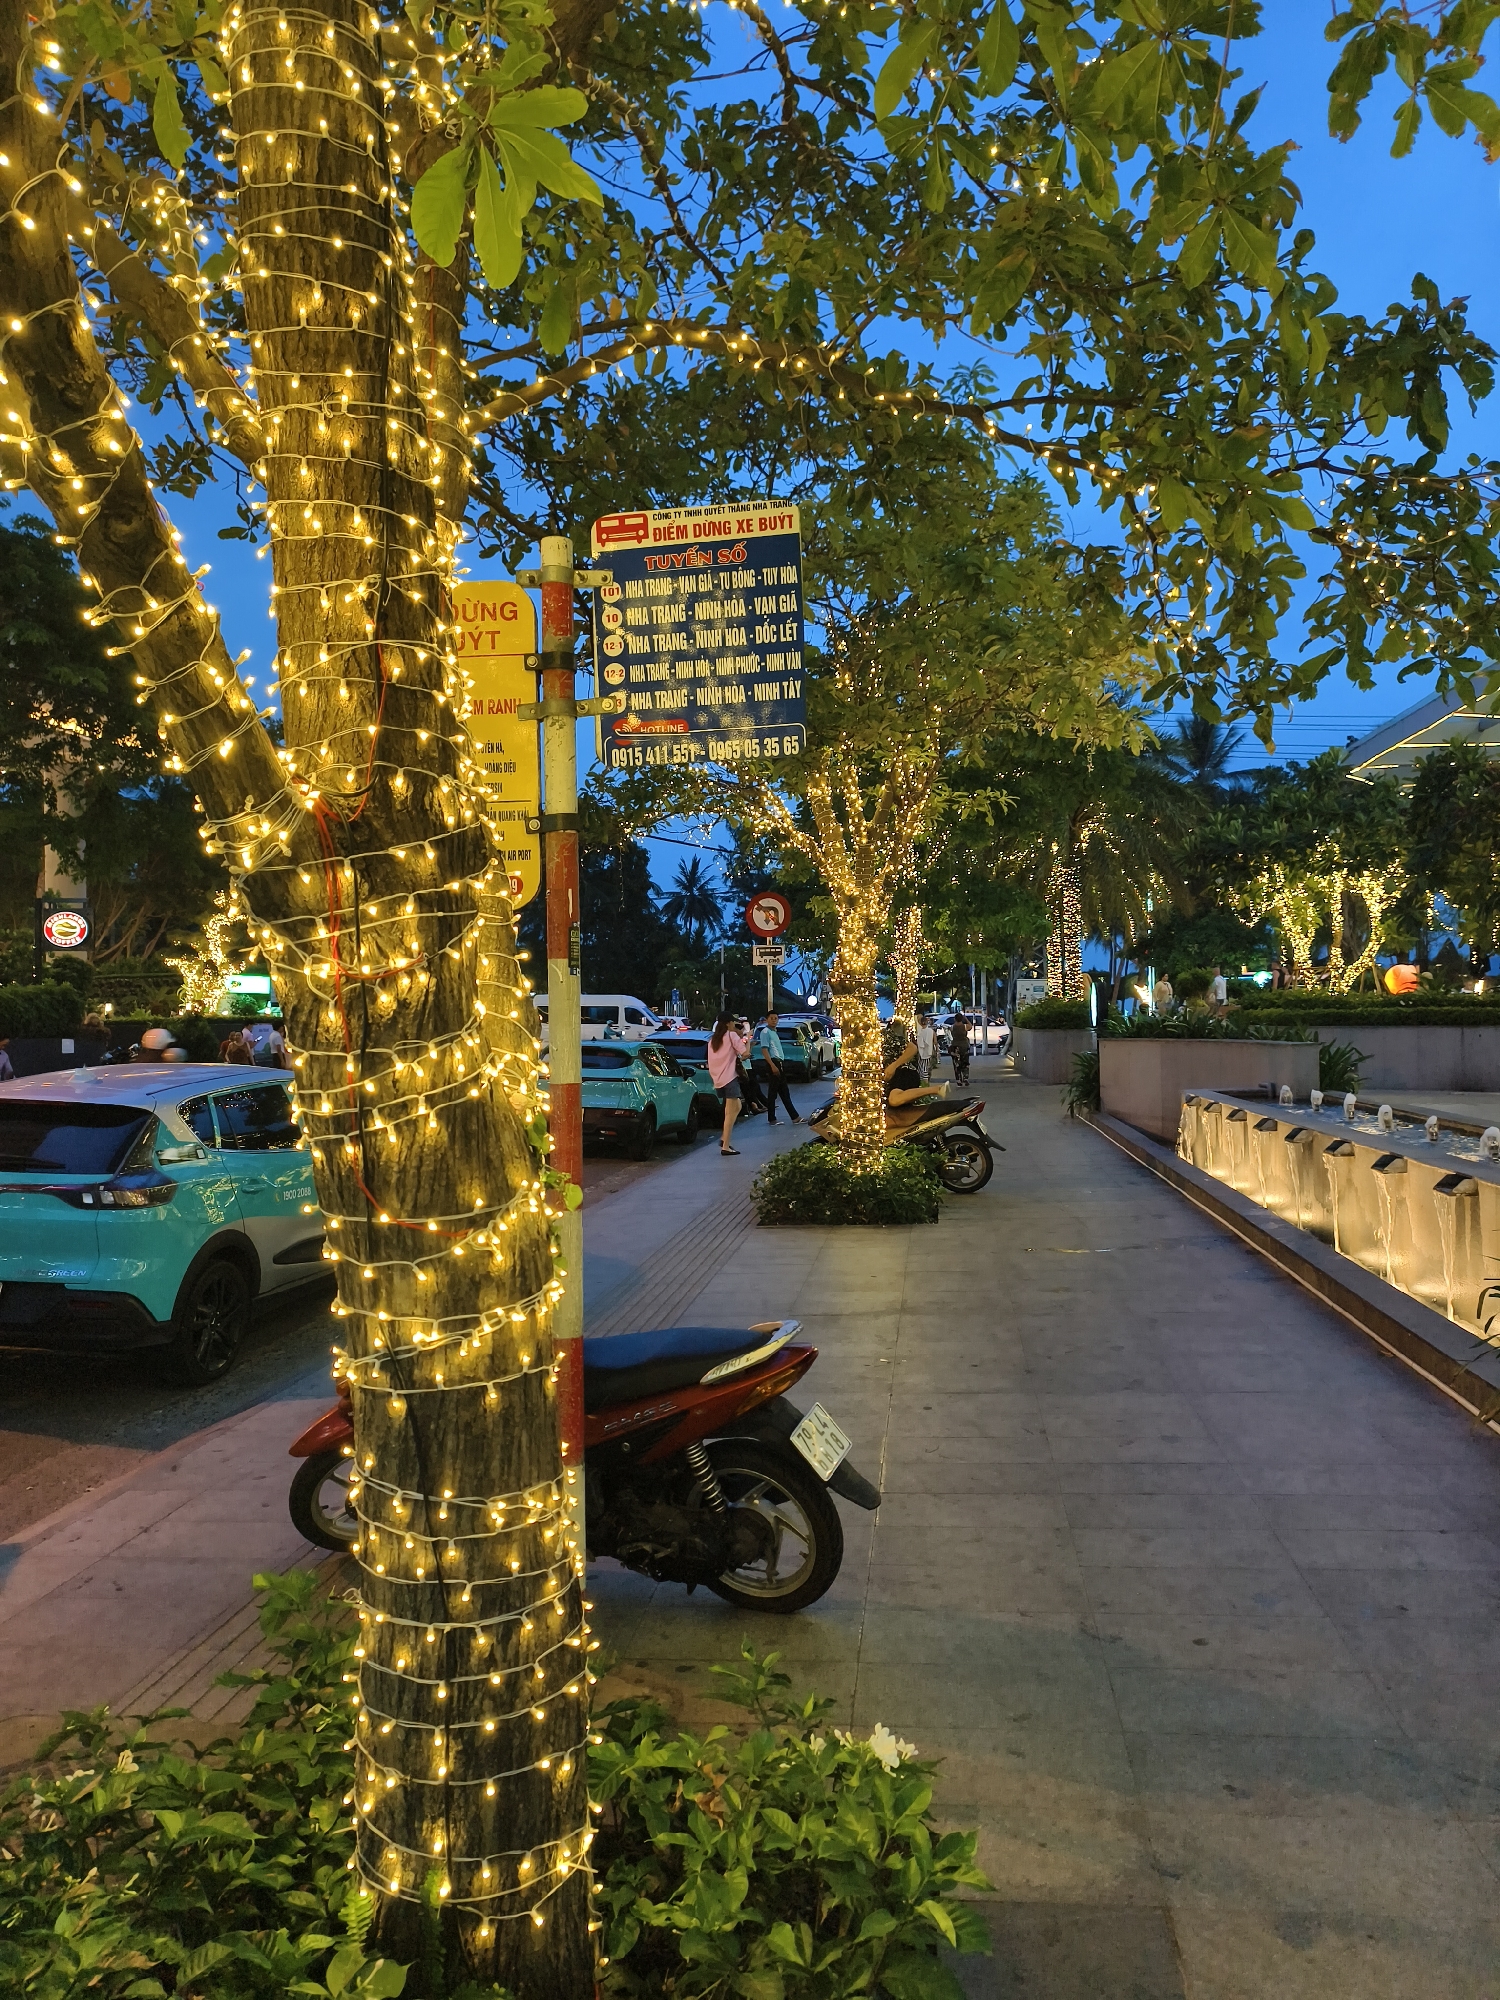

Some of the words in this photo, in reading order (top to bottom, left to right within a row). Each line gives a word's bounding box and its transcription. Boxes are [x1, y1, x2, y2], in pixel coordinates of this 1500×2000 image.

[652, 512, 672, 520] CÔNG
[674, 511, 682, 519] TY
[684, 510, 702, 518] TNHH
[752, 502, 768, 510] NHA
[770, 500, 793, 508] TRANG
[653, 520, 688, 542] ĐIỂM
[693, 519, 732, 538] DỪNG
[736, 518, 754, 534] XE
[759, 512, 794, 532] BUÝT
[644, 545, 712, 570] TUYẾN
[718, 541, 747, 563] SỐ
[603, 587, 620, 597] 101
[625, 580, 644, 598] NHA
[645, 577, 673, 597] TRANG
[679, 575, 696, 597] VẠN
[732, 566, 755, 589] BÔNG
[762, 566, 778, 586] TUY
[780, 562, 798, 584] HÒA
[606, 614, 618, 623] 10
[626, 607, 649, 626] NHA
[651, 604, 686, 624] TRANG
[694, 601, 721, 620] NINH
[724, 595, 746, 618] HÒA
[754, 596, 776, 619] VẠN
[779, 590, 798, 613] GIÃ
[457, 626, 500, 651] UÝT
[605, 642, 622, 650] 12-1
[628, 635, 650, 654] NHA
[653, 632, 687, 652] TRANG
[696, 629, 722, 648] NINH
[725, 623, 747, 647] HÒA
[755, 618, 777, 644] DỐC
[780, 617, 798, 642] LẾT
[606, 669, 624, 678] 12-2
[630, 665, 645, 682] NHA
[646, 662, 670, 681] TRANG
[676, 660, 694, 679] NINH
[695, 654, 710, 678] HÒA
[716, 656, 734, 676] NINH
[766, 652, 785, 672] NINH
[631, 692, 652, 710] NHA
[655, 688, 688, 708] TRANG
[696, 687, 722, 706] NINH
[725, 681, 746, 704] HÒA
[754, 682, 780, 702] NINH
[782, 677, 801, 699] TÂY
[640, 724, 684, 732] HOTLINE
[612, 747, 642, 767] 0915
[646, 746, 668, 765] 411
[673, 744, 695, 763] 551
[708, 740, 741, 761] 0965
[744, 739, 760, 758] 05
[764, 737, 780, 757] 35
[783, 736, 799, 756] 65
[508, 850, 517, 860] AIR
[518, 850, 531, 860] PORT
[283, 1189, 296, 1201] 1900
